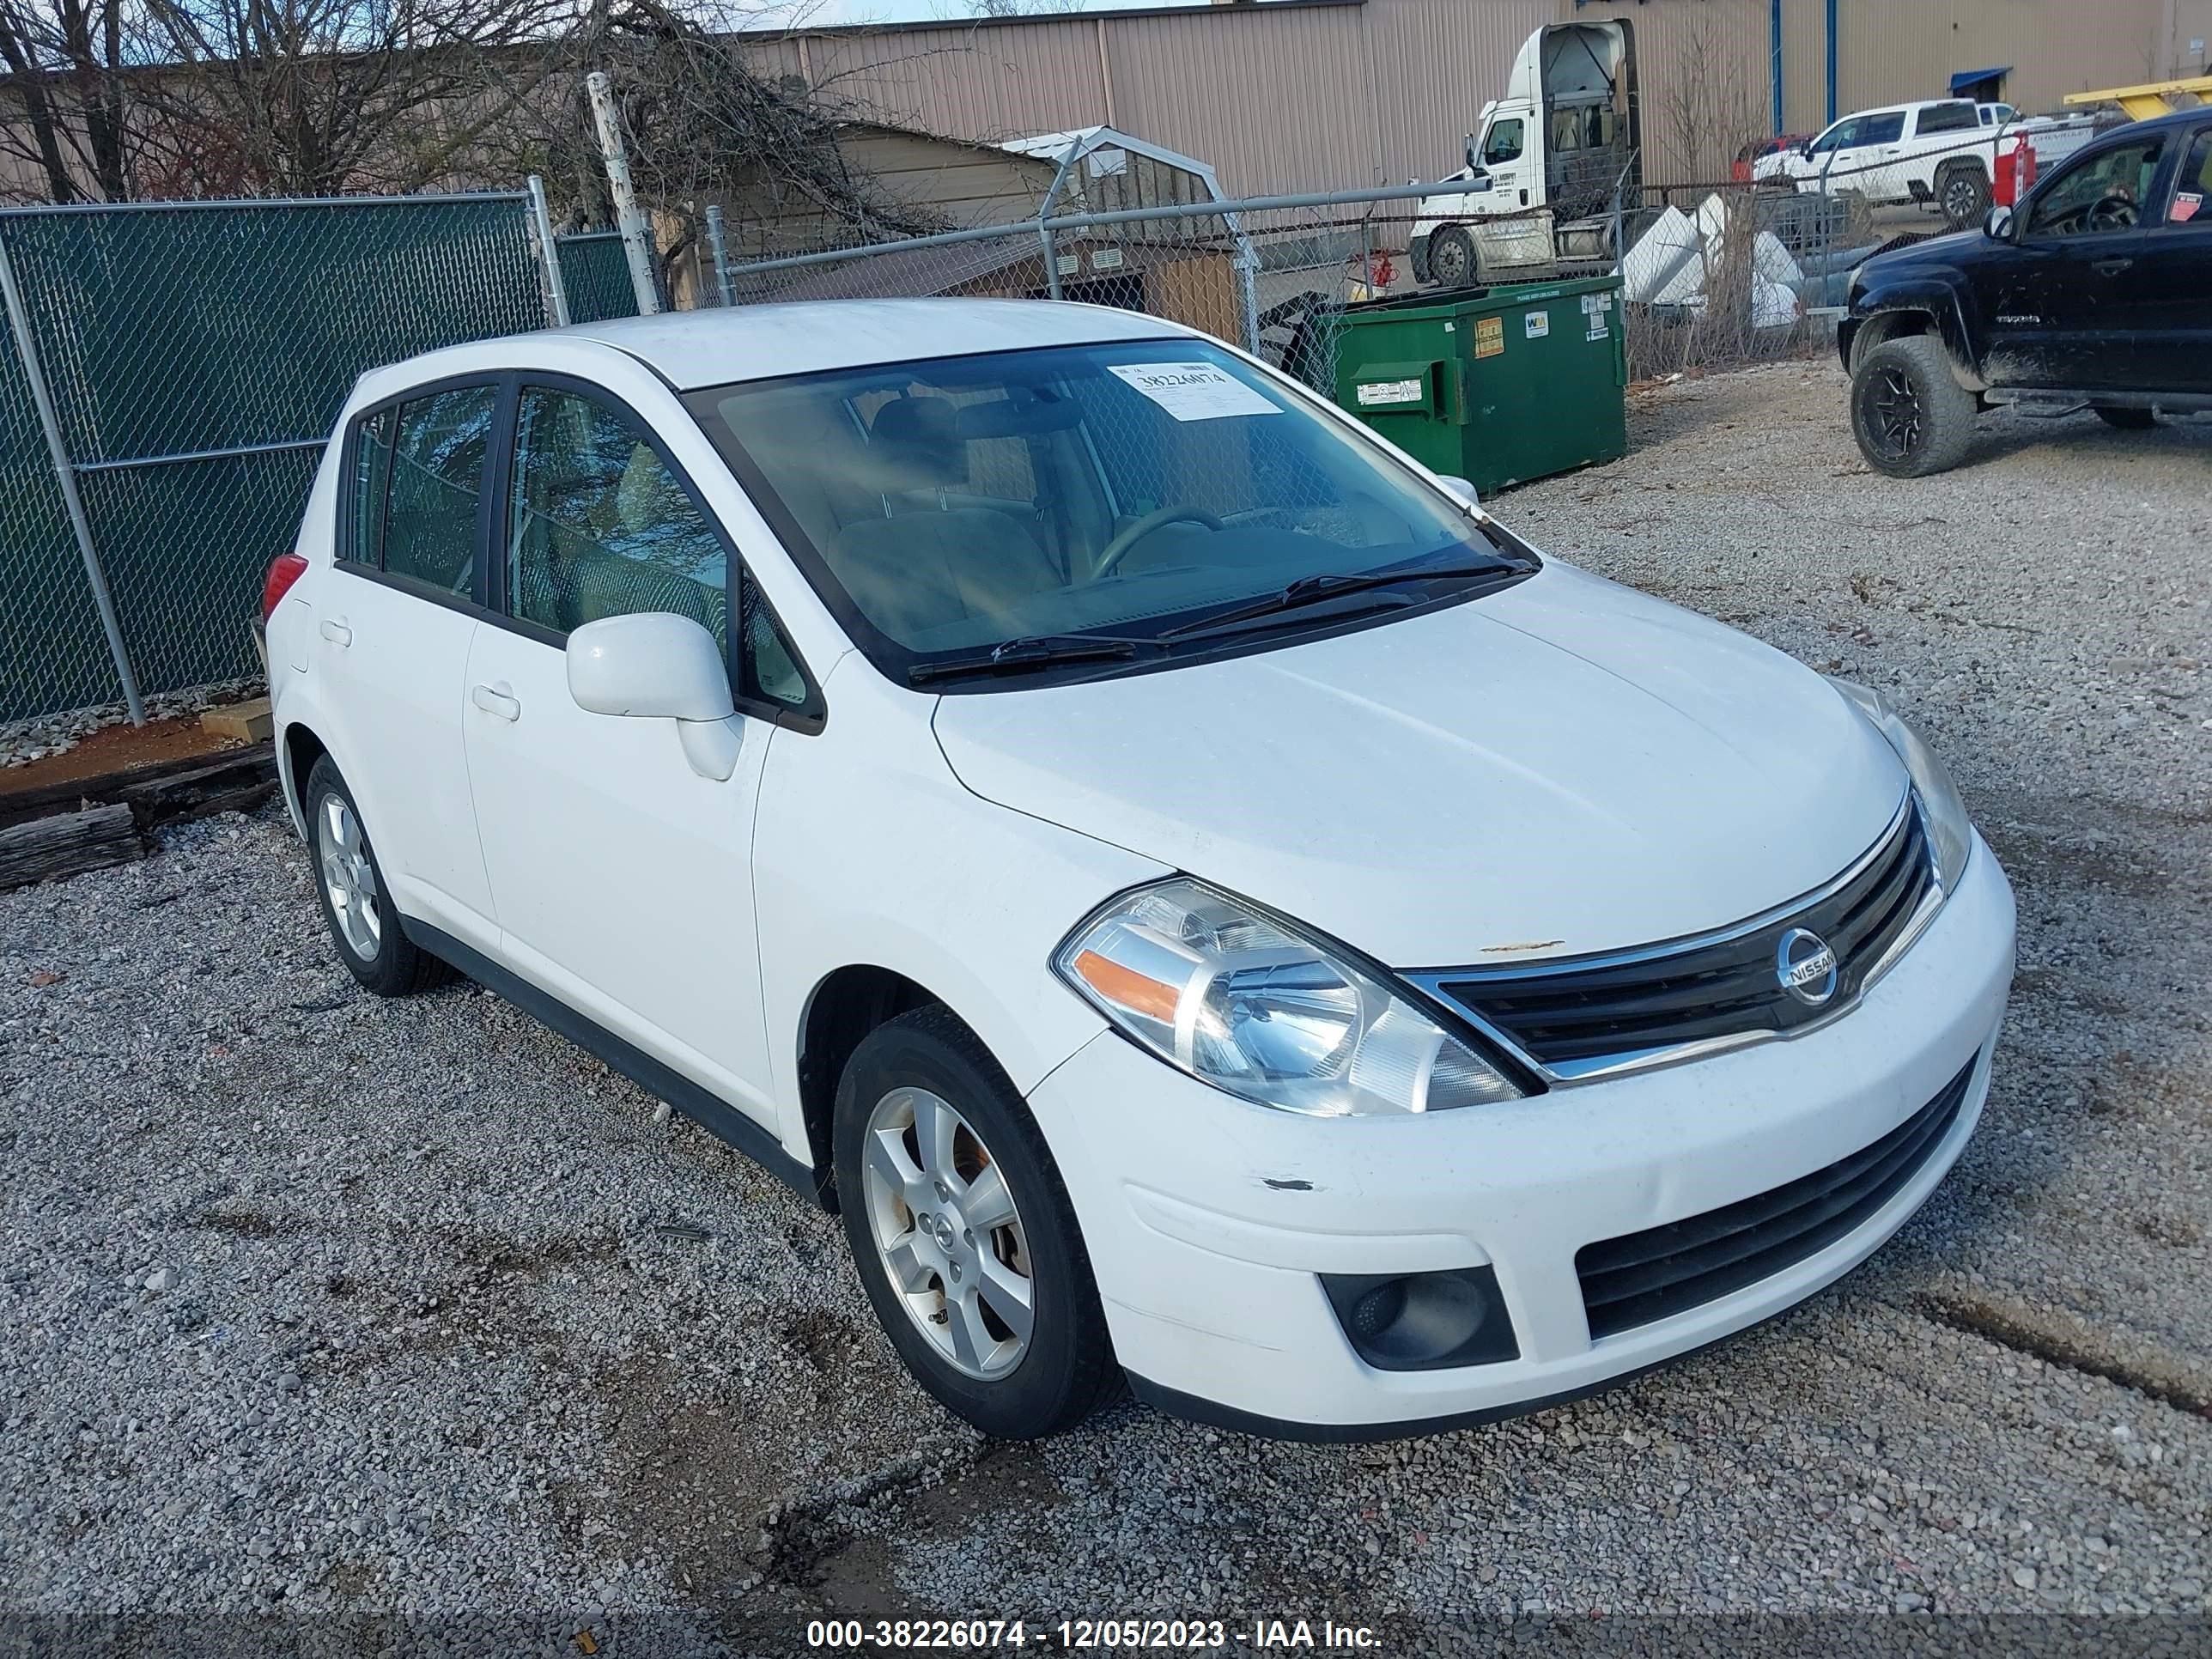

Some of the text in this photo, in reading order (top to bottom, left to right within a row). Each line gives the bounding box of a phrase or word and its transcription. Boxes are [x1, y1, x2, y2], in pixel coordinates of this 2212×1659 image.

[1528, 316, 1547, 328] WM
[1137, 373, 1226, 388] 38226074
[1790, 951, 1835, 983] NISSAN
